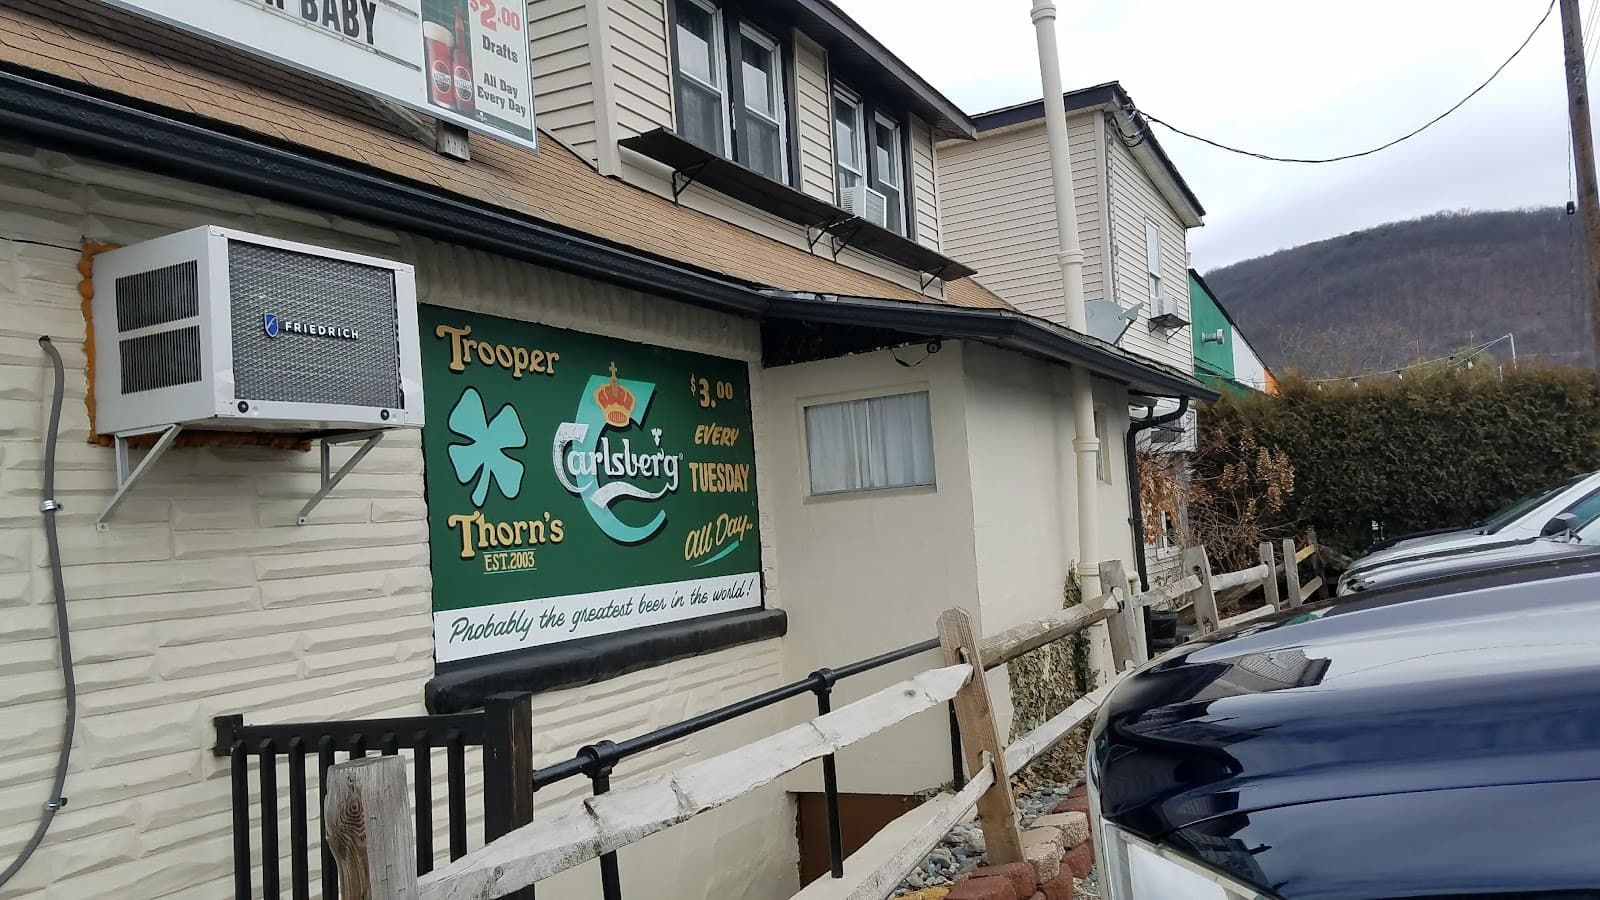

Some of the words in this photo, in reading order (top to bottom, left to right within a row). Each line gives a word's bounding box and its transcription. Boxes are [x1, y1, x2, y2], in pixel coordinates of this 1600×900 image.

[300, 0, 377, 45] BABY
[482, 34, 518, 63] Drafts
[484, 72, 497, 88] All
[500, 79, 518, 99] Day
[477, 85, 505, 109] Every
[508, 98, 526, 118] Day
[285, 321, 360, 339] FRIEDRICH
[436, 324, 560, 378] Trooper
[694, 422, 739, 447] EVERY
[552, 422, 680, 493] Carlsberg
[688, 462, 749, 492] TUESDAY
[448, 511, 564, 558] Thorn's
[484, 551, 535, 571] EST.2003
[449, 612, 534, 644] Probably
[539, 611, 565, 629] the
[570, 600, 633, 632] greatest
[638, 597, 667, 612] beer
[671, 590, 684, 608] in
[690, 585, 708, 605] the
[712, 579, 753, 602] world!
